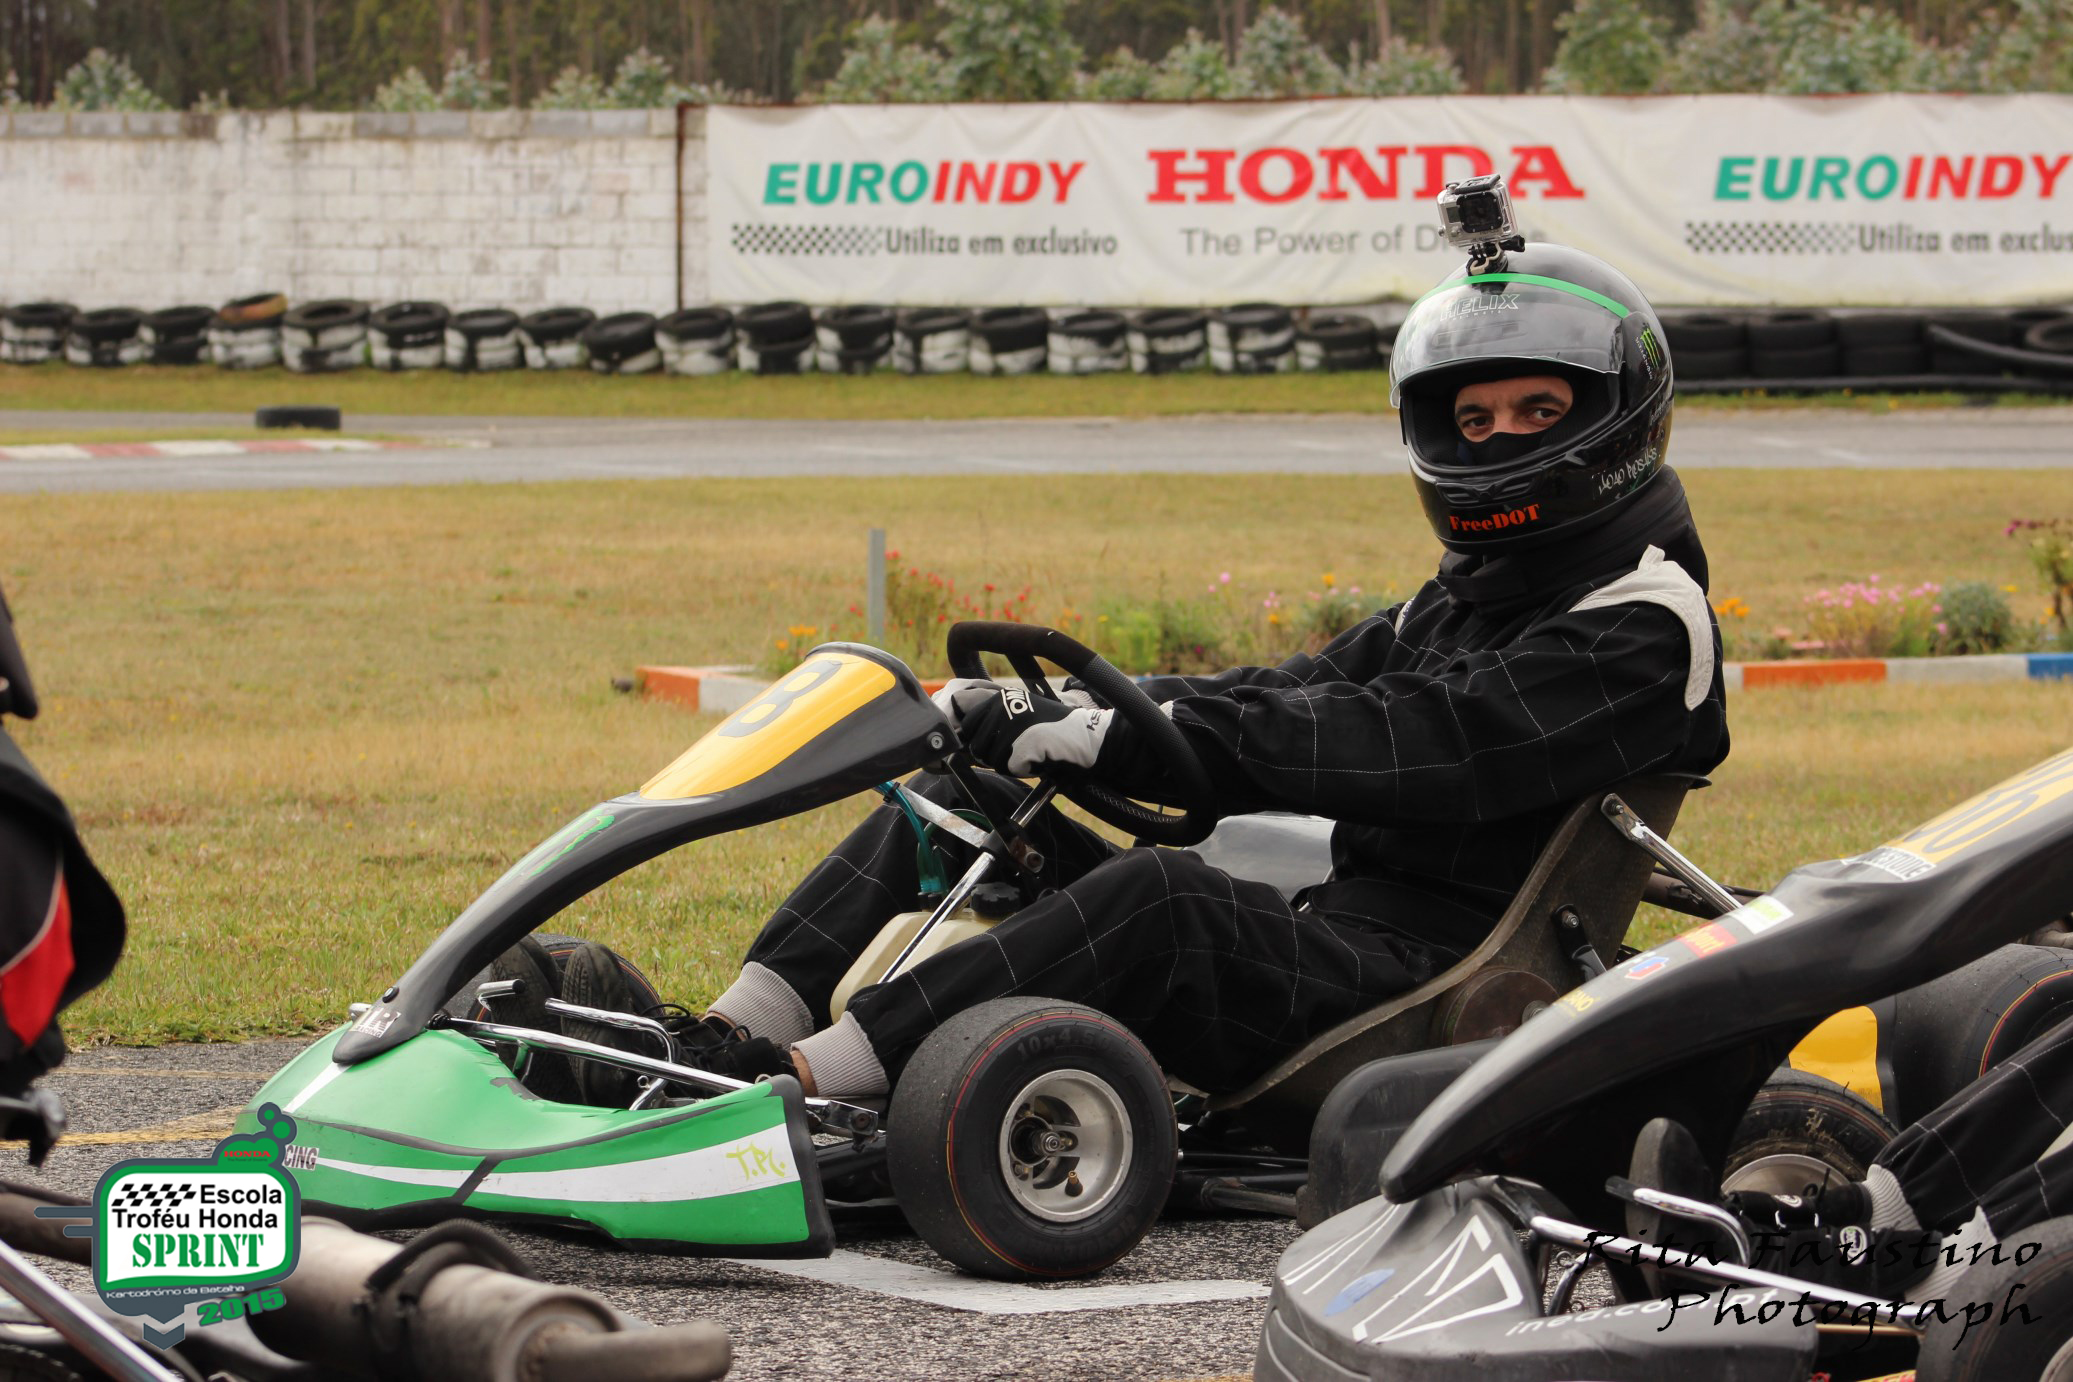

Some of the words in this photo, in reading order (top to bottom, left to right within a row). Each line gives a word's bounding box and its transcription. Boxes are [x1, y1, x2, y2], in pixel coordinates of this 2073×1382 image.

[762, 161, 1085, 206] EUROINDY
[1147, 145, 1585, 205] HONDA
[1714, 154, 2073, 201] EUROINDY
[886, 226, 960, 254] Utiliza
[968, 235, 1004, 254] em
[1013, 226, 1118, 254] exclusivo
[1180, 228, 1242, 255] The
[1254, 227, 1359, 254] Power
[1371, 224, 1404, 252] of
[1859, 223, 1940, 252] Utiliza
[1951, 232, 1991, 252] em
[1439, 294, 1520, 321] HELIX
[1449, 504, 1541, 531] FreeDOT
